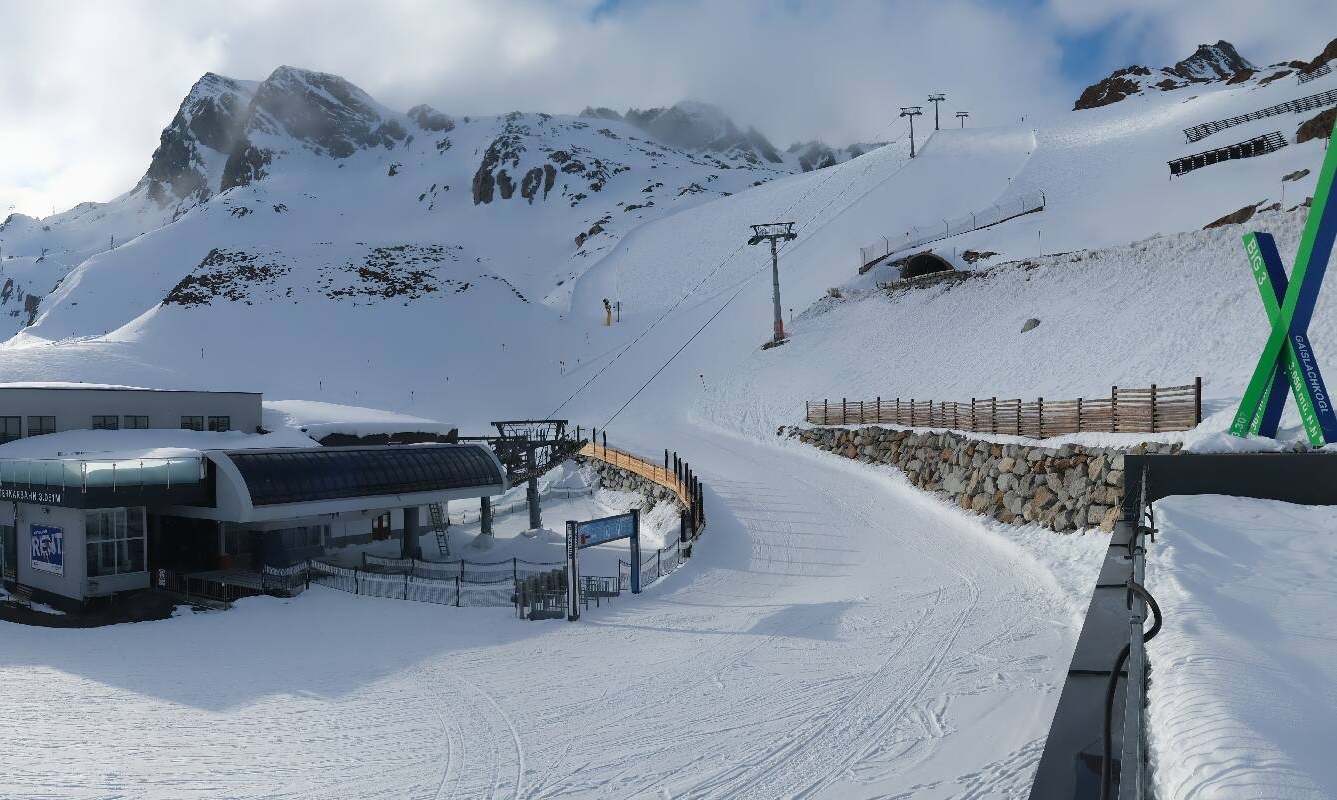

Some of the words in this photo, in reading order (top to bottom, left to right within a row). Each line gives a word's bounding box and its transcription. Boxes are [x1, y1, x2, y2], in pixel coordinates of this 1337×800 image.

[1247, 238, 1262, 271] BIG
[1258, 271, 1267, 285] 3
[1295, 335, 1328, 414] GAISLACHKOGL
[31, 532, 63, 557] RENT
